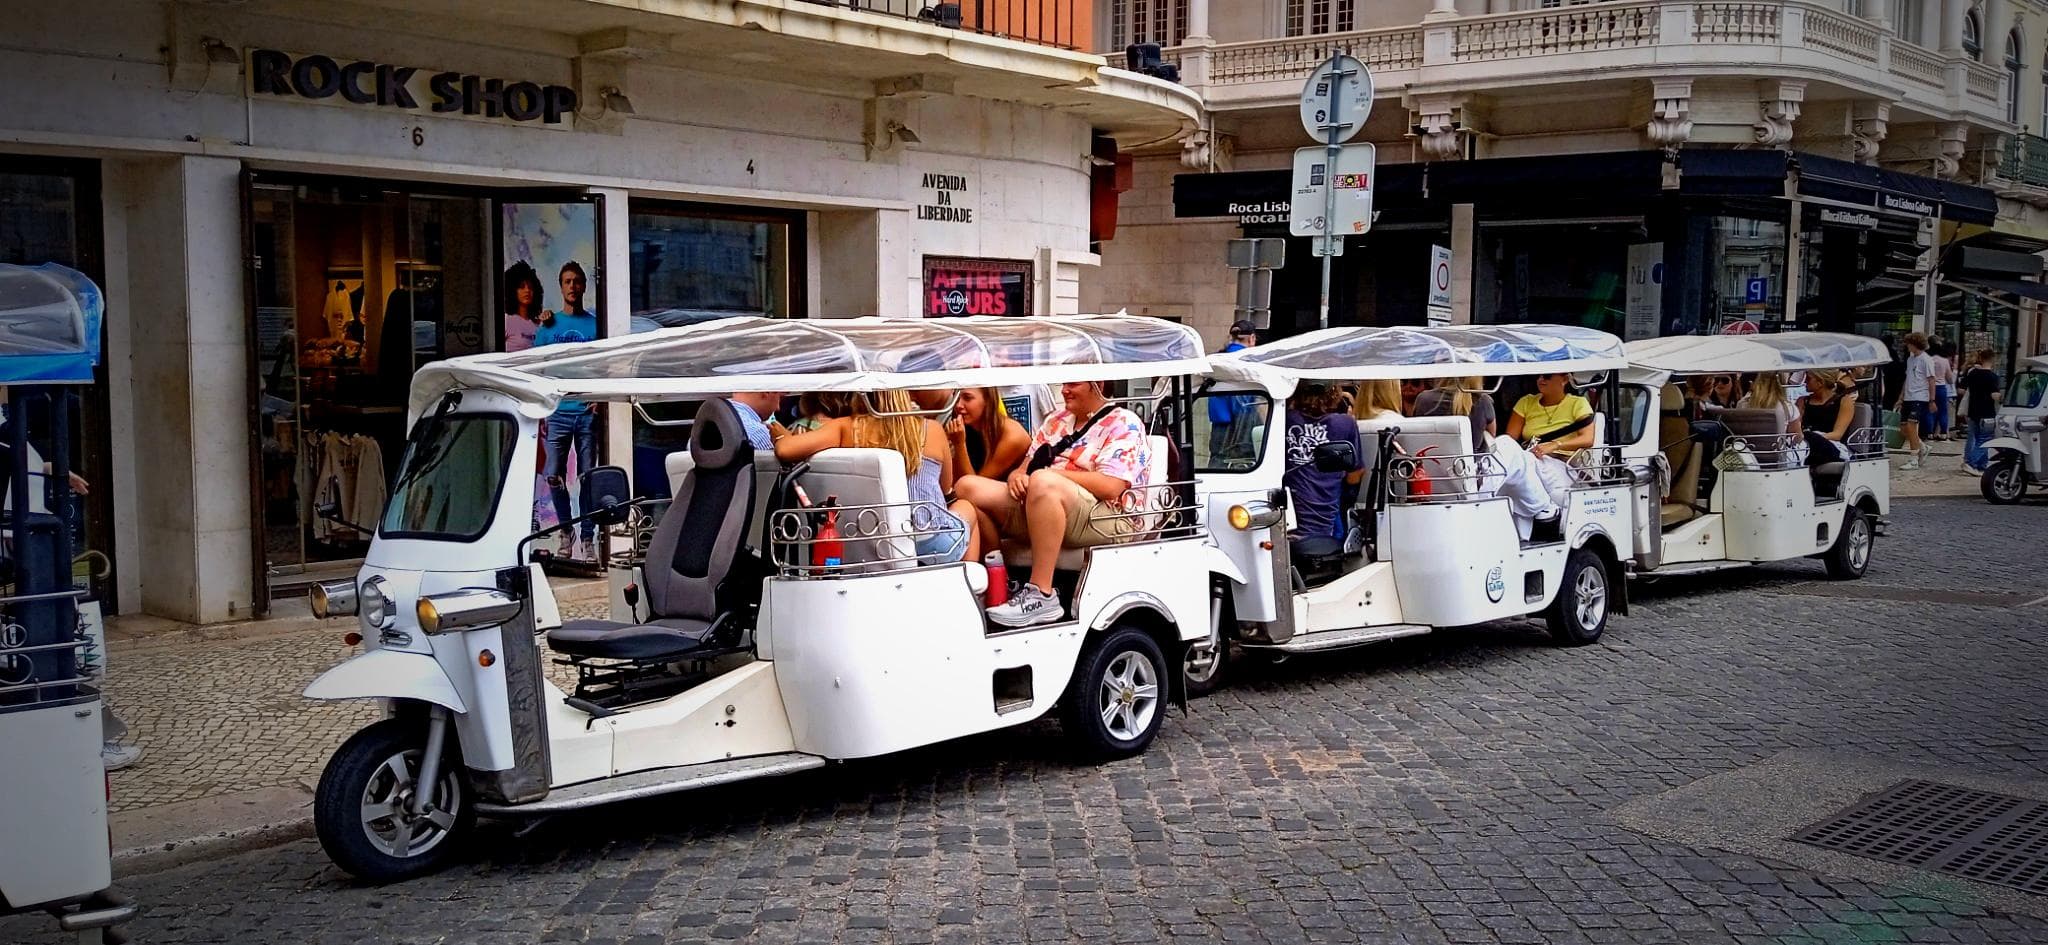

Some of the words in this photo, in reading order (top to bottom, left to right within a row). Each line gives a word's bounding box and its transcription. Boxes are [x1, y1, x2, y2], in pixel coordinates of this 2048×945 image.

[252, 49, 418, 109] ROCK
[430, 71, 577, 124] SHOP
[412, 127, 423, 147] 6
[746, 159, 754, 175] 4
[921, 172, 967, 192] AVENIDA
[937, 191, 951, 206] DA
[1229, 202, 1261, 214] Roca
[1264, 200, 1292, 213] Lisb
[1885, 194, 1898, 207] Roca
[1898, 197, 1915, 211] Lisboa
[1915, 200, 1933, 216] Gallery
[917, 204, 972, 224] LIBERDADE
[932, 269, 1002, 289] AFTER
[1007, 405, 1026, 413] OKYO
[1021, 601, 1043, 613] HOKA
